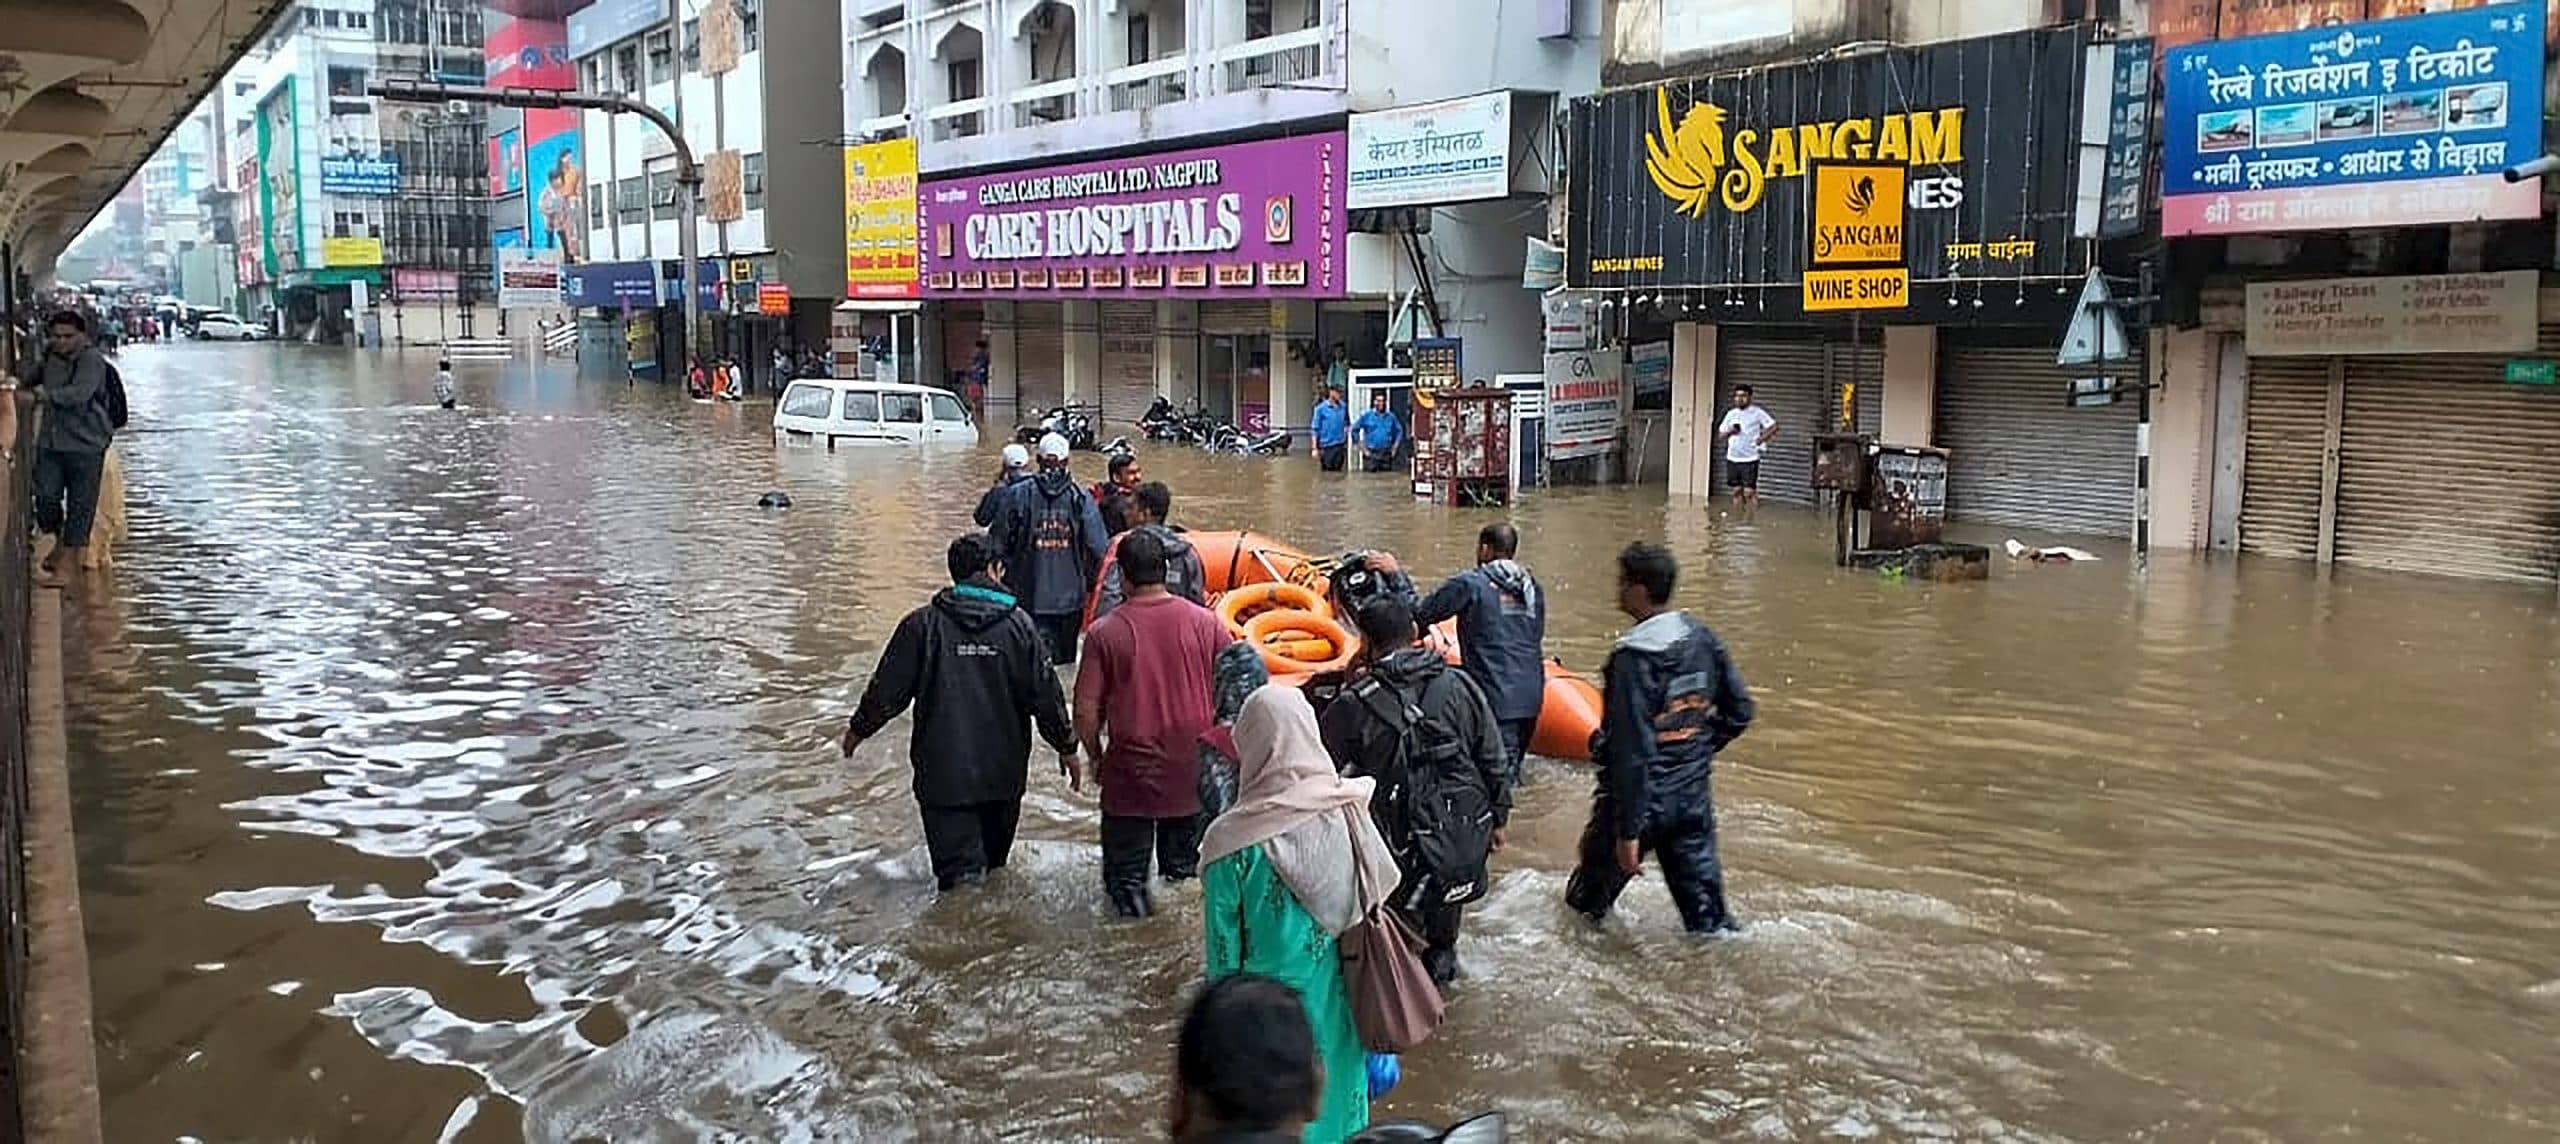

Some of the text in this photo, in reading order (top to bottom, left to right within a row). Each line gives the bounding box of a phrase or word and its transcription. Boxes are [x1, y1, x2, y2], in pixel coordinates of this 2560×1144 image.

[2207, 65, 2254, 104] रेल्वे
[2263, 55, 2369, 98] रिजर्वेशन
[2379, 57, 2399, 92] इ
[2408, 38, 2498, 83] टिकीट
[1367, 136, 1409, 161] केयर
[1722, 107, 1965, 212] SANGAM
[2339, 149, 2404, 175] आधार
[2410, 139, 2430, 171] से
[979, 181, 1018, 206] GANGA
[1018, 177, 1050, 202] CARE
[1053, 169, 1117, 198] HOSPITAL
[1119, 166, 1152, 192] LTD.
[1155, 158, 1219, 189] NAGPUR
[2204, 155, 2241, 185] मनी
[965, 211, 1043, 260] CARE
[1046, 193, 1241, 257] HOSPITALS
[2205, 195, 2230, 225] श्री
[1816, 223, 1900, 258] SANGAM
[1591, 257, 1632, 273] SANGAM
[1810, 277, 1903, 301] WINE SHOP
